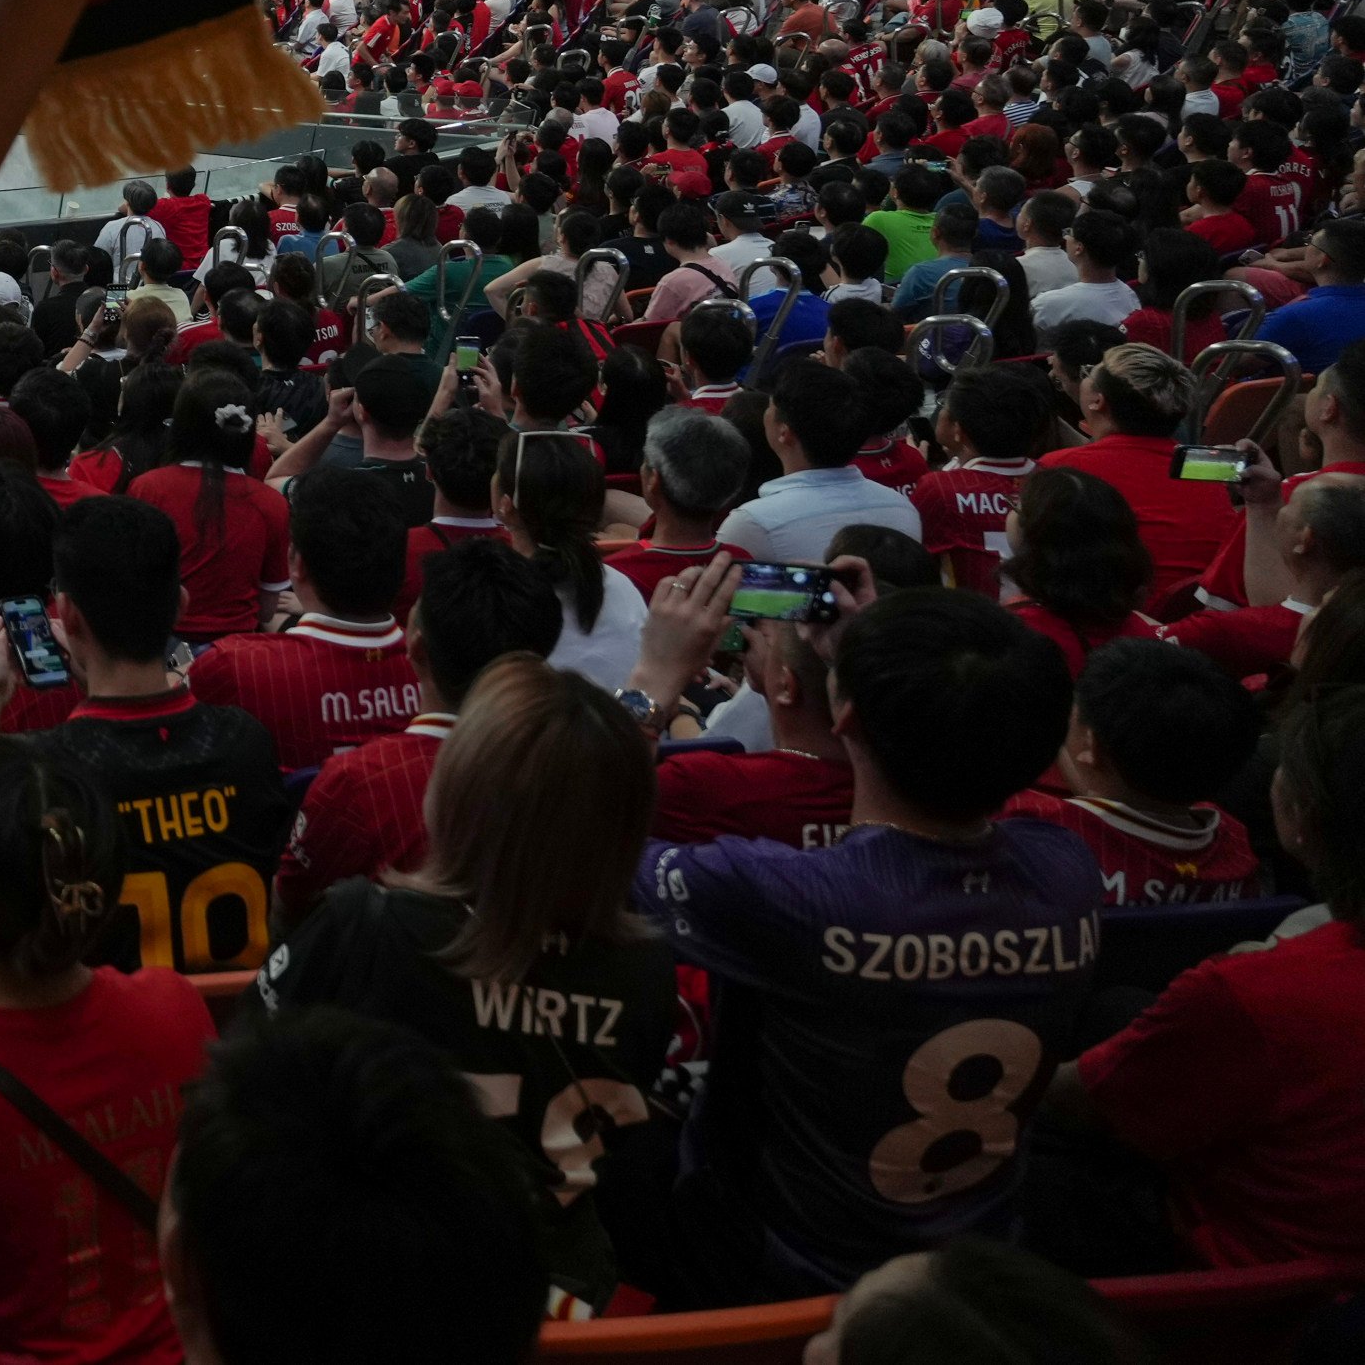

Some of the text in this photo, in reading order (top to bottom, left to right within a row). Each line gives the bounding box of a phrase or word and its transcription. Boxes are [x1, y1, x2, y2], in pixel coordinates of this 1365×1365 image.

[320, 682, 422, 723] M.SALA
[118, 785, 238, 846] "THEO"
[118, 863, 271, 972] 10
[472, 978, 627, 1049] WIRTZ
[17, 1084, 184, 1169] M.ALAH
[868, 1018, 1043, 1204] 8
